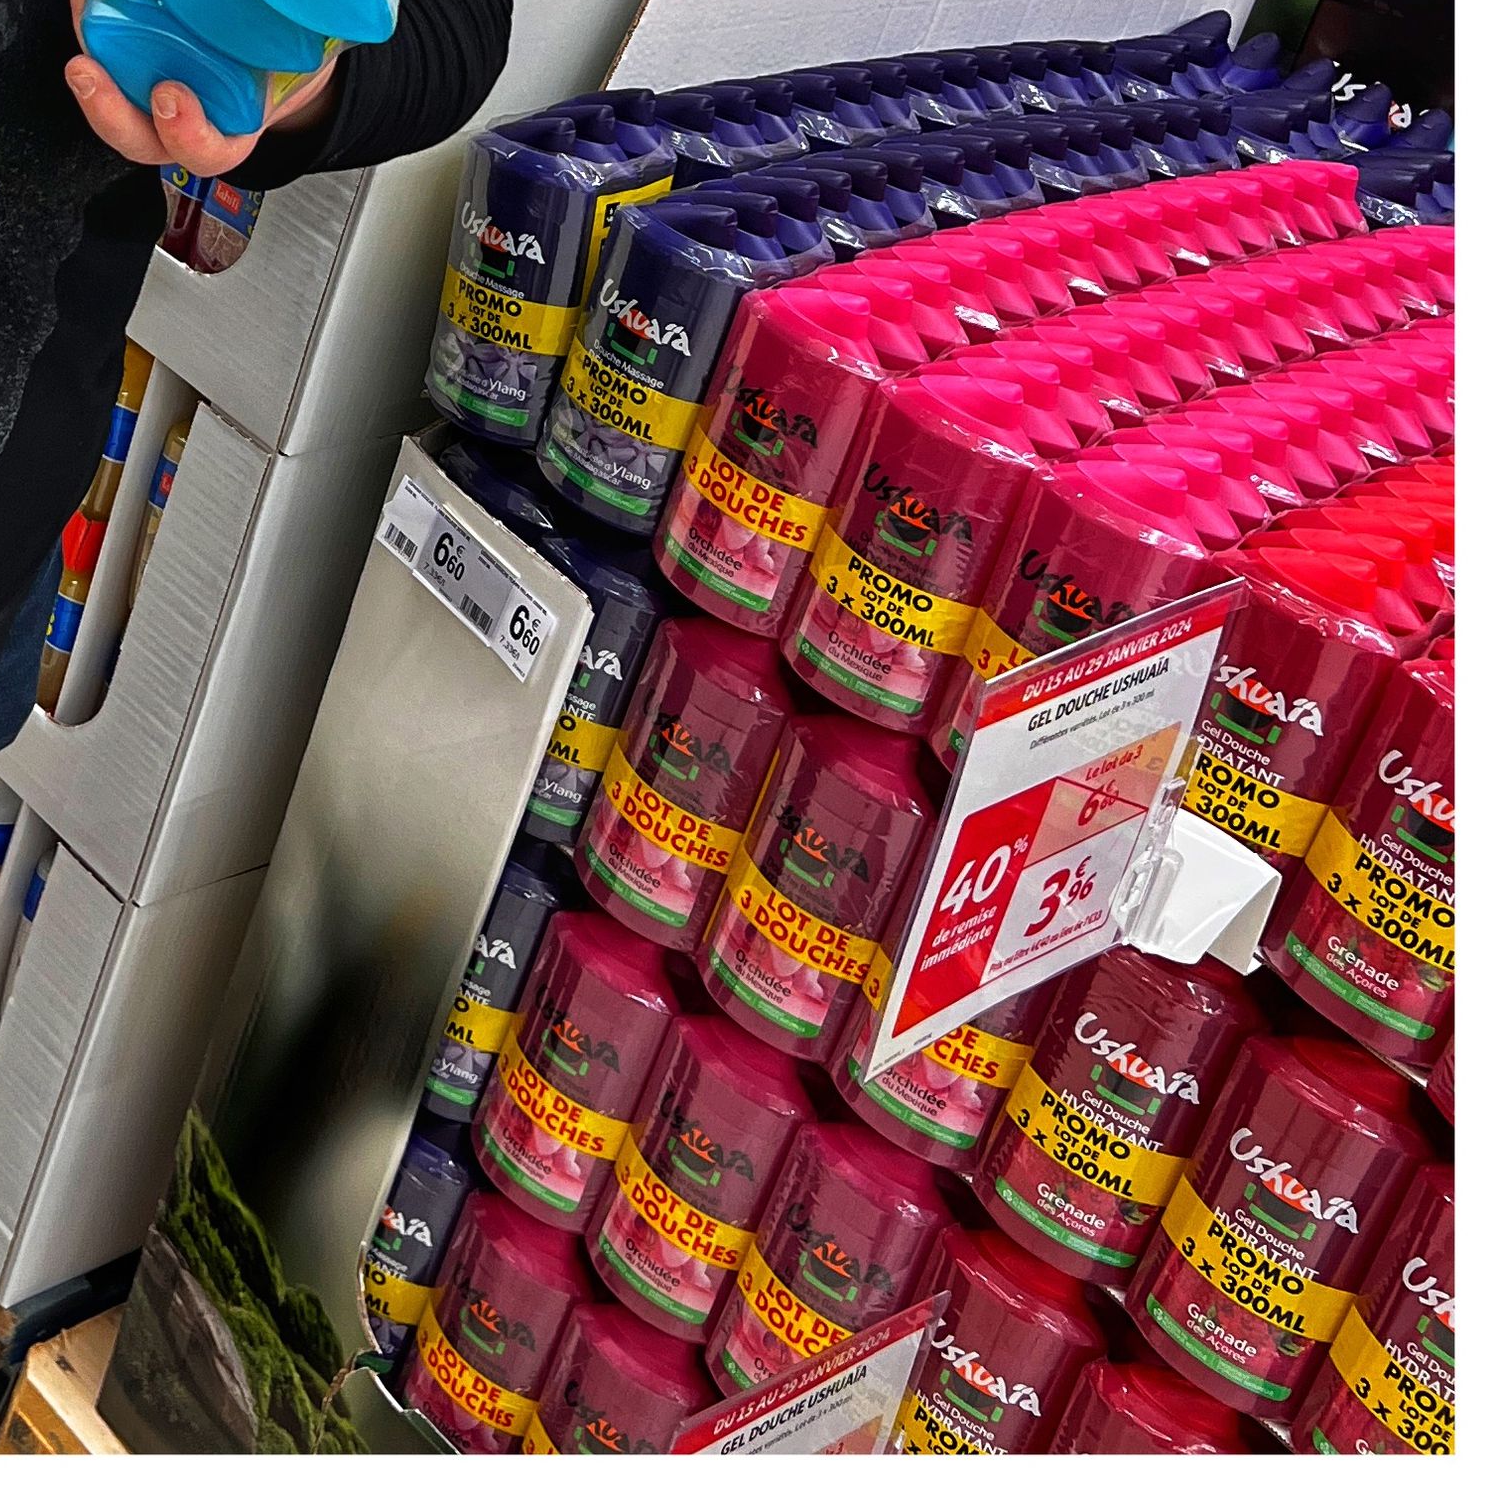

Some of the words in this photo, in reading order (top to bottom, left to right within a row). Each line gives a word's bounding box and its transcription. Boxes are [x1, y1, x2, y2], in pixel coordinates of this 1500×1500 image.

[458, 278, 522, 318] PROMO
[459, 261, 485, 286] Douche
[485, 276, 525, 300] Massage
[446, 305, 455, 319] 3
[469, 317, 533, 350] 300ML
[488, 378, 526, 401] Ylang
[613, 462, 650, 490] Ylang
[848, 556, 932, 612] PROMO
[860, 586, 886, 607] LOT
[887, 602, 903, 617] DE
[828, 631, 891, 675] Orchidée
[840, 651, 883, 682] Mexique
[1022, 684, 1046, 702] DU
[1046, 680, 1063, 692] 15
[1063, 668, 1084, 684] AU
[1085, 659, 1103, 675] 29
[1104, 635, 1159, 668] JANVIER
[1160, 618, 1192, 644] 2024
[1028, 707, 1052, 732] GEL
[1055, 683, 1111, 721] DOUCHE
[1113, 656, 1169, 695] USHUAÏA
[612, 781, 621, 800] 3
[623, 795, 729, 866] DOUCHES
[609, 843, 660, 887] Orchidée
[1356, 854, 1455, 927] PROMO
[1369, 889, 1398, 912] LOT
[1400, 907, 1421, 929] DE
[919, 925, 993, 973] immédiate
[931, 927, 954, 950] de
[954, 906, 998, 944] remise
[736, 951, 792, 997] Orchidée
[1326, 953, 1345, 970] des
[1346, 964, 1387, 998] Açores
[1328, 936, 1399, 990] Grenade
[1074, 1012, 1200, 1104] Ushuaïa
[506, 1073, 604, 1154] DOUCHES
[1082, 1091, 1101, 1107] Gel
[1101, 1103, 1150, 1135] Douche
[502, 1125, 552, 1176] Orchidée
[1053, 1125, 1078, 1145] LOT
[1080, 1145, 1099, 1162] DE
[621, 1165, 632, 1188] 3
[631, 1187, 739, 1264] DOUCHES
[1037, 1183, 1105, 1229] Grenade
[1037, 1198, 1056, 1214] des
[1057, 1208, 1095, 1236] Açores
[1214, 1207, 1319, 1279] HYDRATANT
[1186, 1319, 1207, 1336] des
[1207, 1329, 1246, 1363] Açores
[1187, 1303, 1257, 1356] Grenade
[427, 1352, 513, 1428] DOUCHES
[720, 1429, 746, 1456] GEL
[747, 1401, 805, 1445] DOUCHE
[807, 1365, 868, 1410] USHUAÏA
[932, 1391, 952, 1411] Gel
[952, 1408, 995, 1441] Douche
